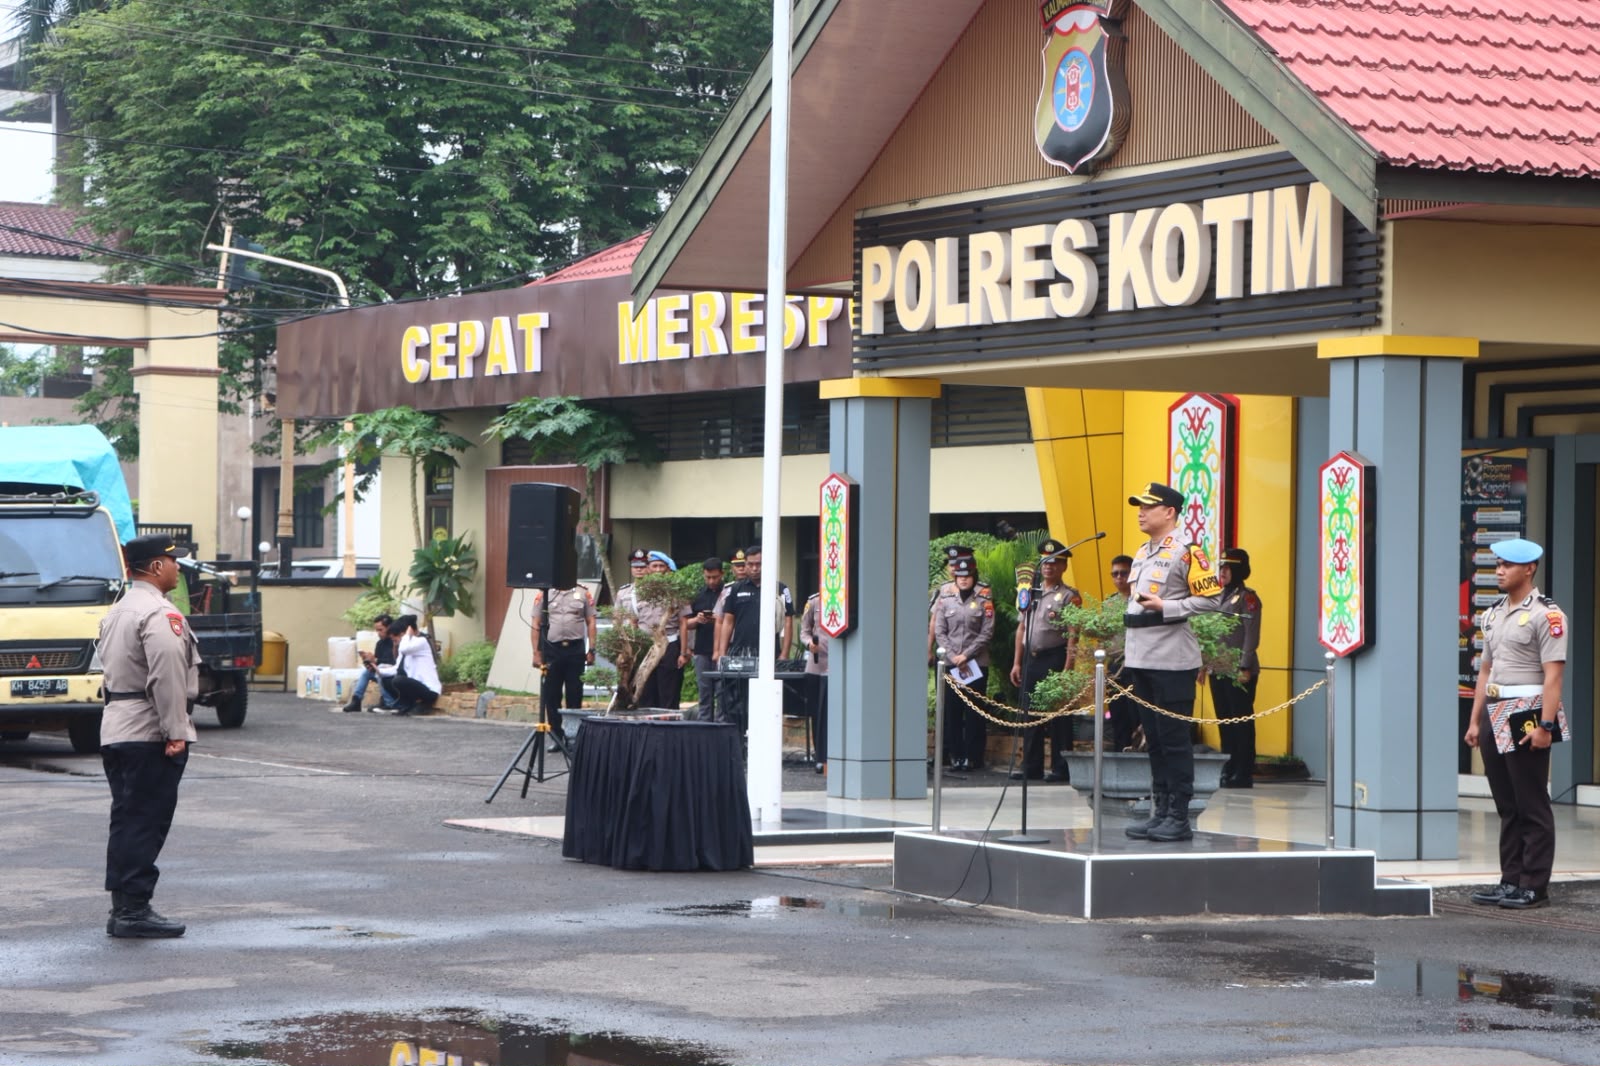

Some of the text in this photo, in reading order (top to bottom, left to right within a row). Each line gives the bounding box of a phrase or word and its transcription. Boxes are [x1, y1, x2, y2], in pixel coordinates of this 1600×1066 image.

[861, 181, 1343, 335] POLRES KOTIM
[401, 312, 549, 384] CEPAT
[1483, 463, 1512, 472] Program
[1482, 482, 1511, 492] Kapolri
[11, 680, 23, 691] KH
